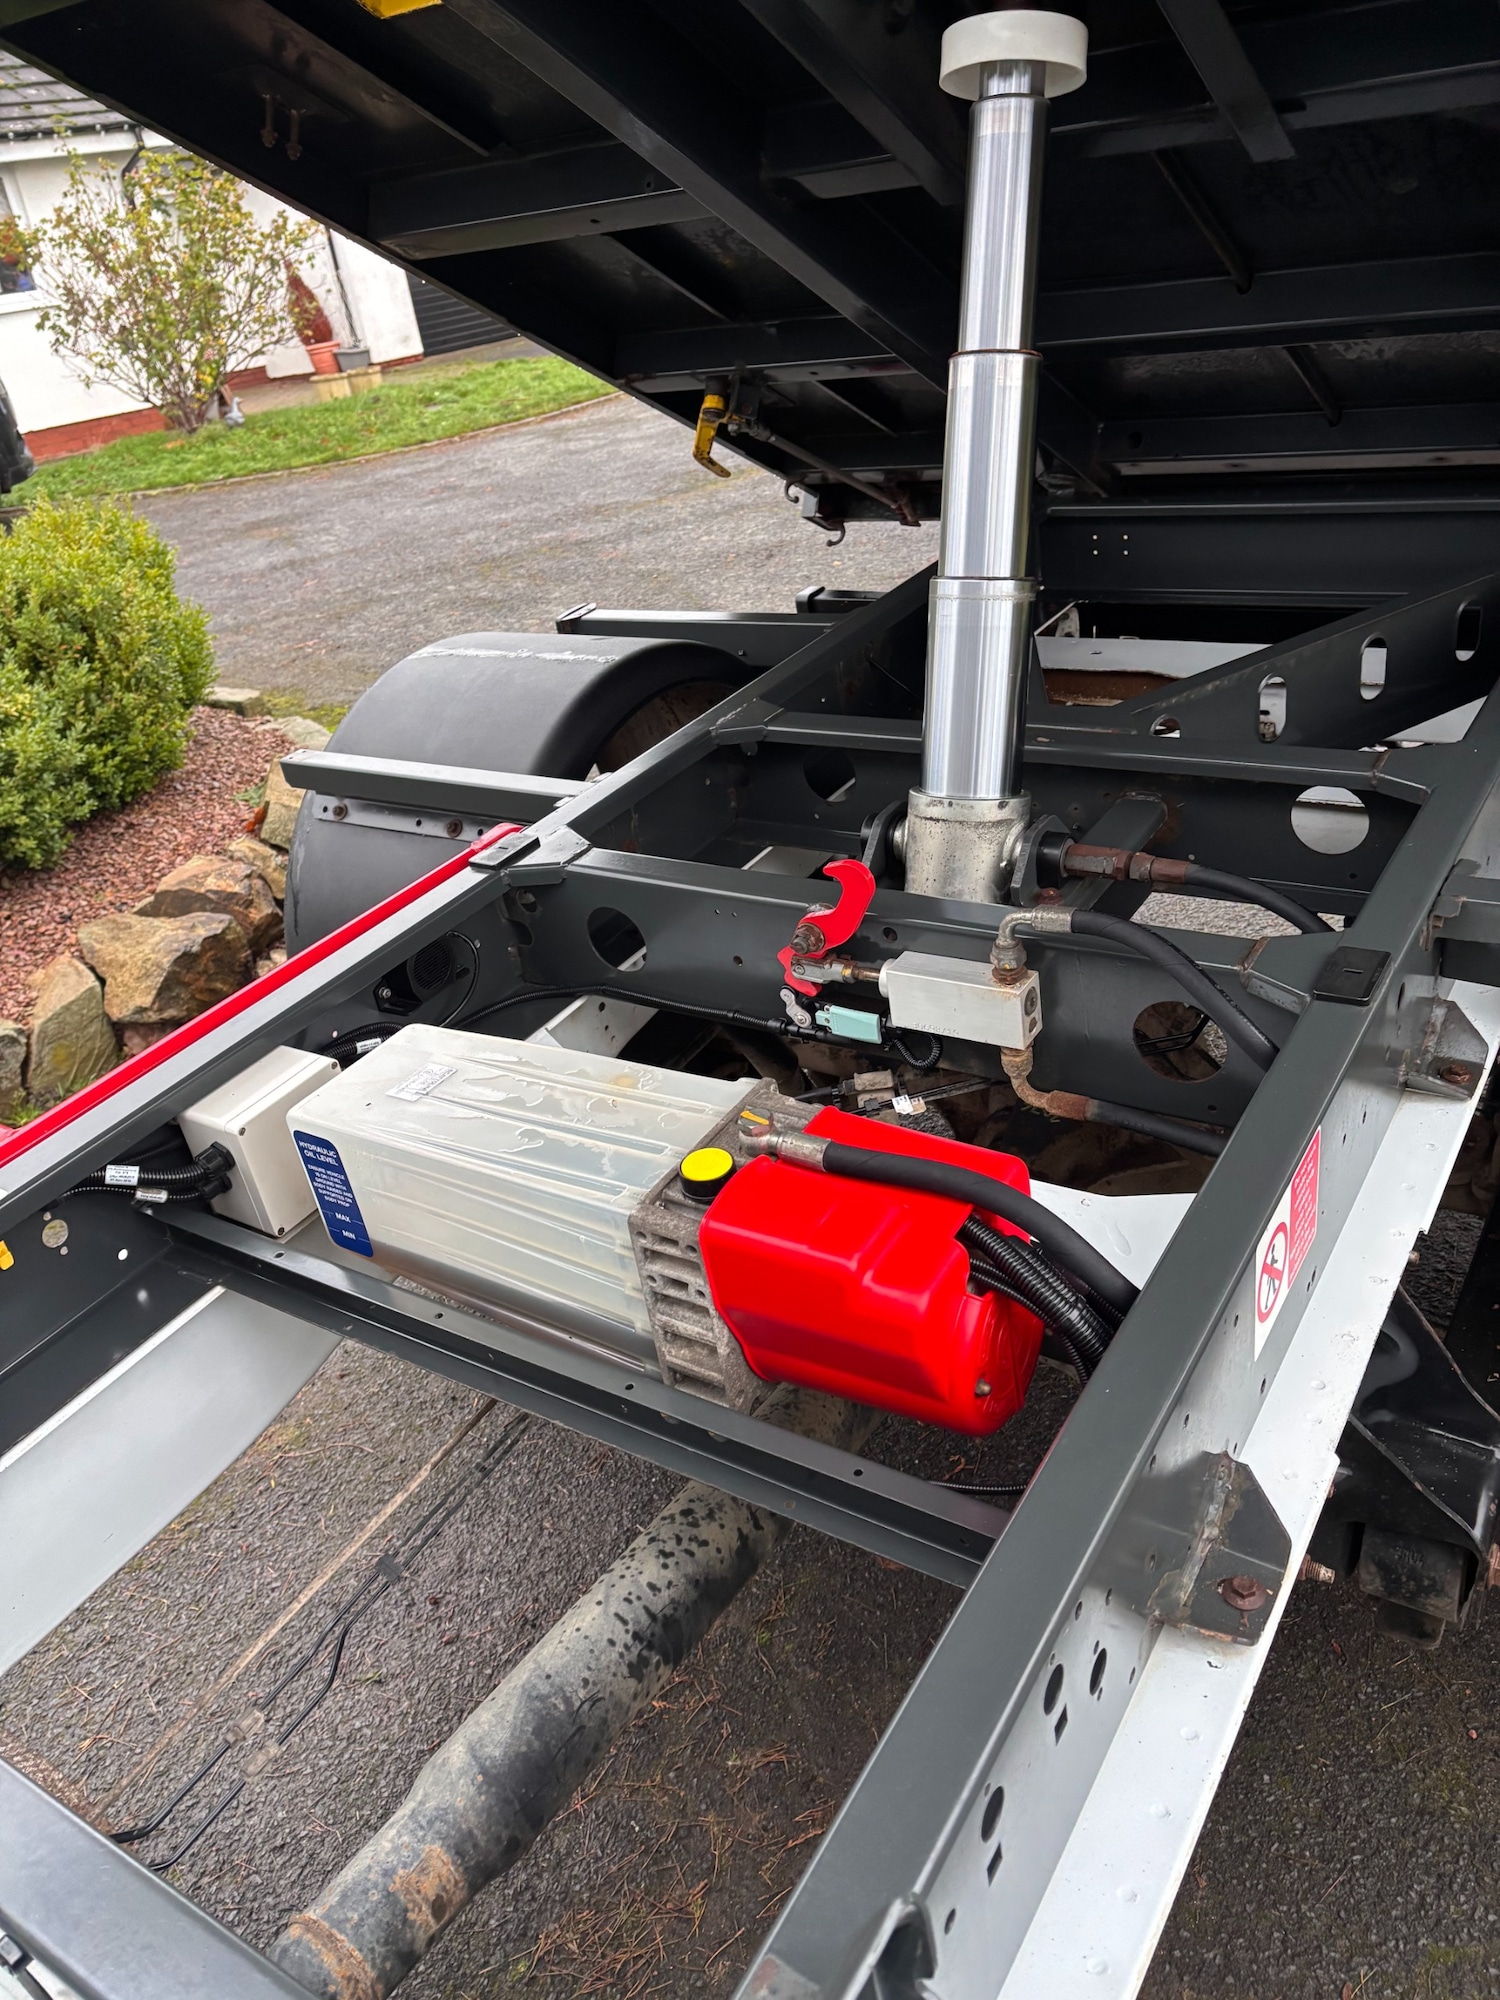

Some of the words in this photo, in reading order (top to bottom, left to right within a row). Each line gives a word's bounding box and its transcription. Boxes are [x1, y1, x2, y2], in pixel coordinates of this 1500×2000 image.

[299, 1140, 337, 1158] HYDRAULIC
[304, 1149, 316, 1159] OIL
[317, 1153, 339, 1166] LEVEL
[326, 1170, 345, 1180] VEHICLE
[328, 1176, 342, 1184] LEVEL
[335, 1212, 351, 1223] MAX
[342, 1229, 356, 1240] MIN
